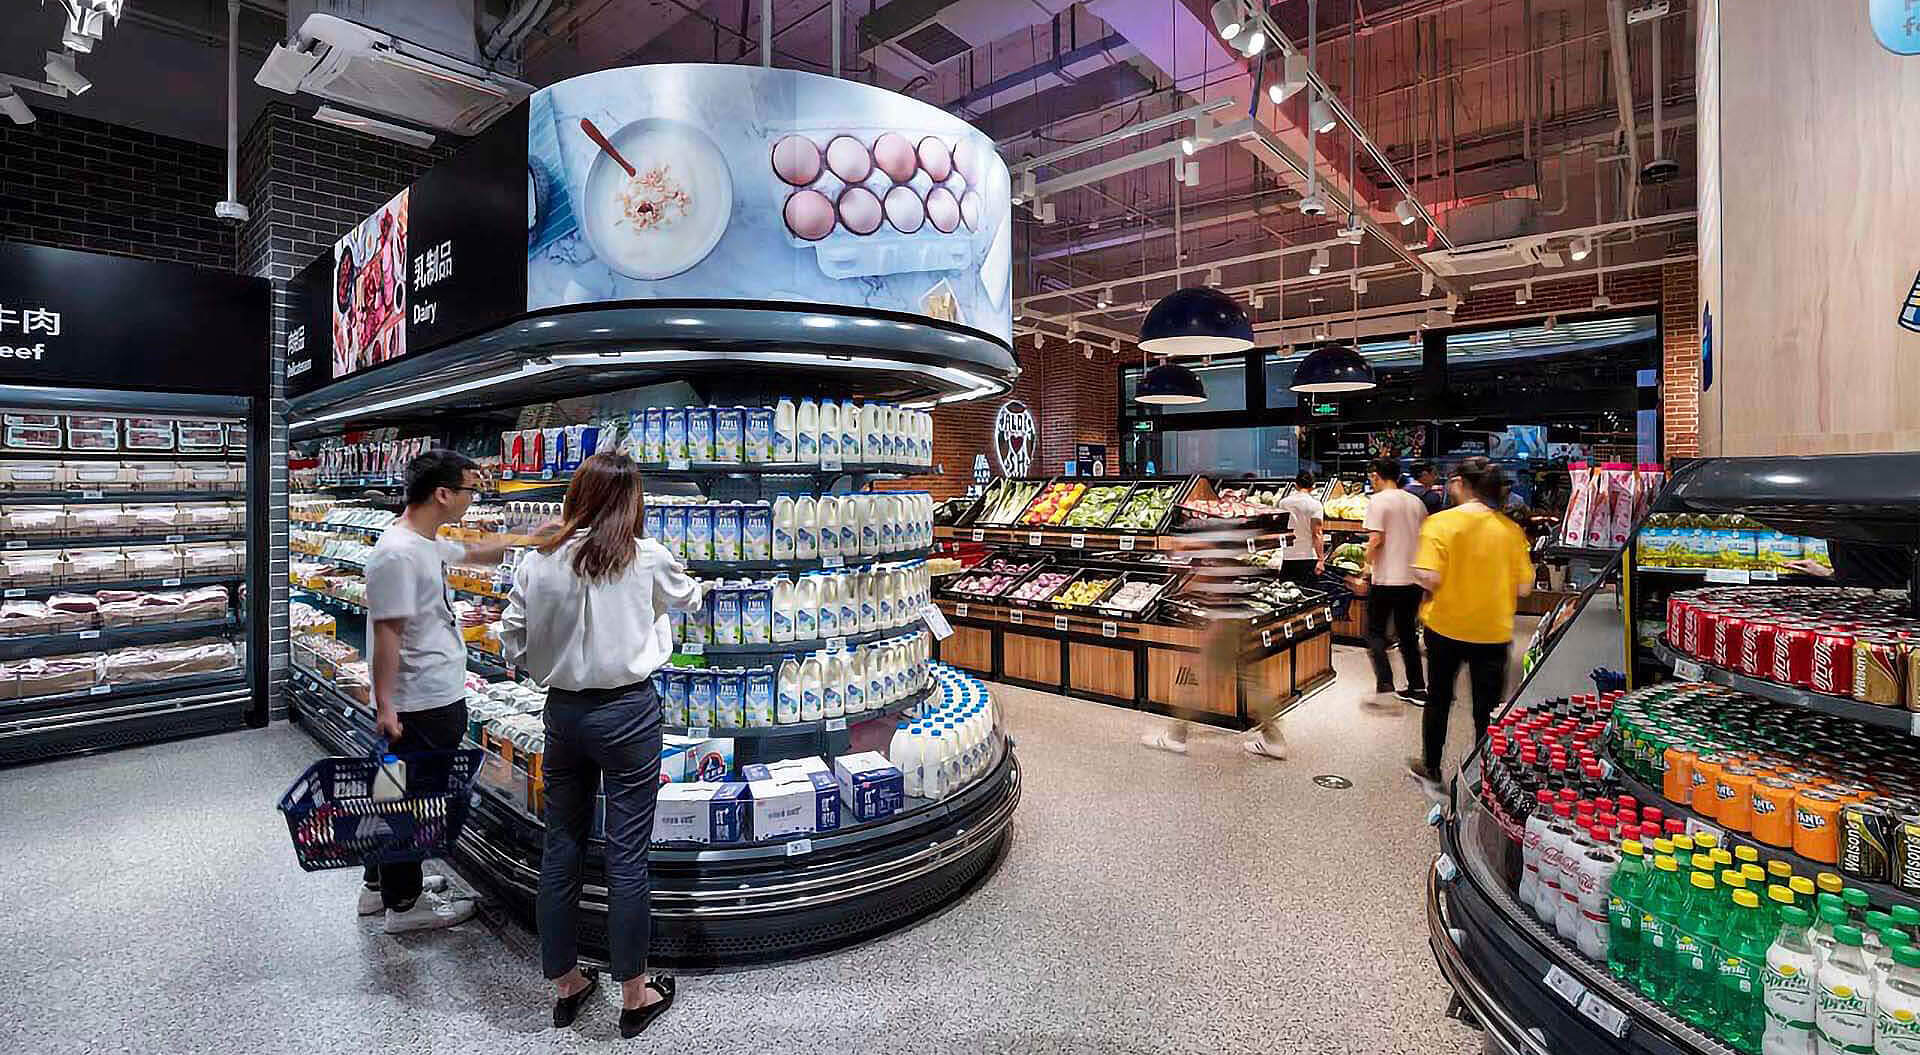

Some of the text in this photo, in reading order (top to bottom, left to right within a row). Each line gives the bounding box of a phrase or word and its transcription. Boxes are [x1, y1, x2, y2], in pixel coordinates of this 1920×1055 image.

[413, 240, 452, 292] 乳制品
[413, 300, 437, 325] Dairy
[1844, 822, 1861, 873] Watson's
[1818, 990, 1863, 1011] Sprite
